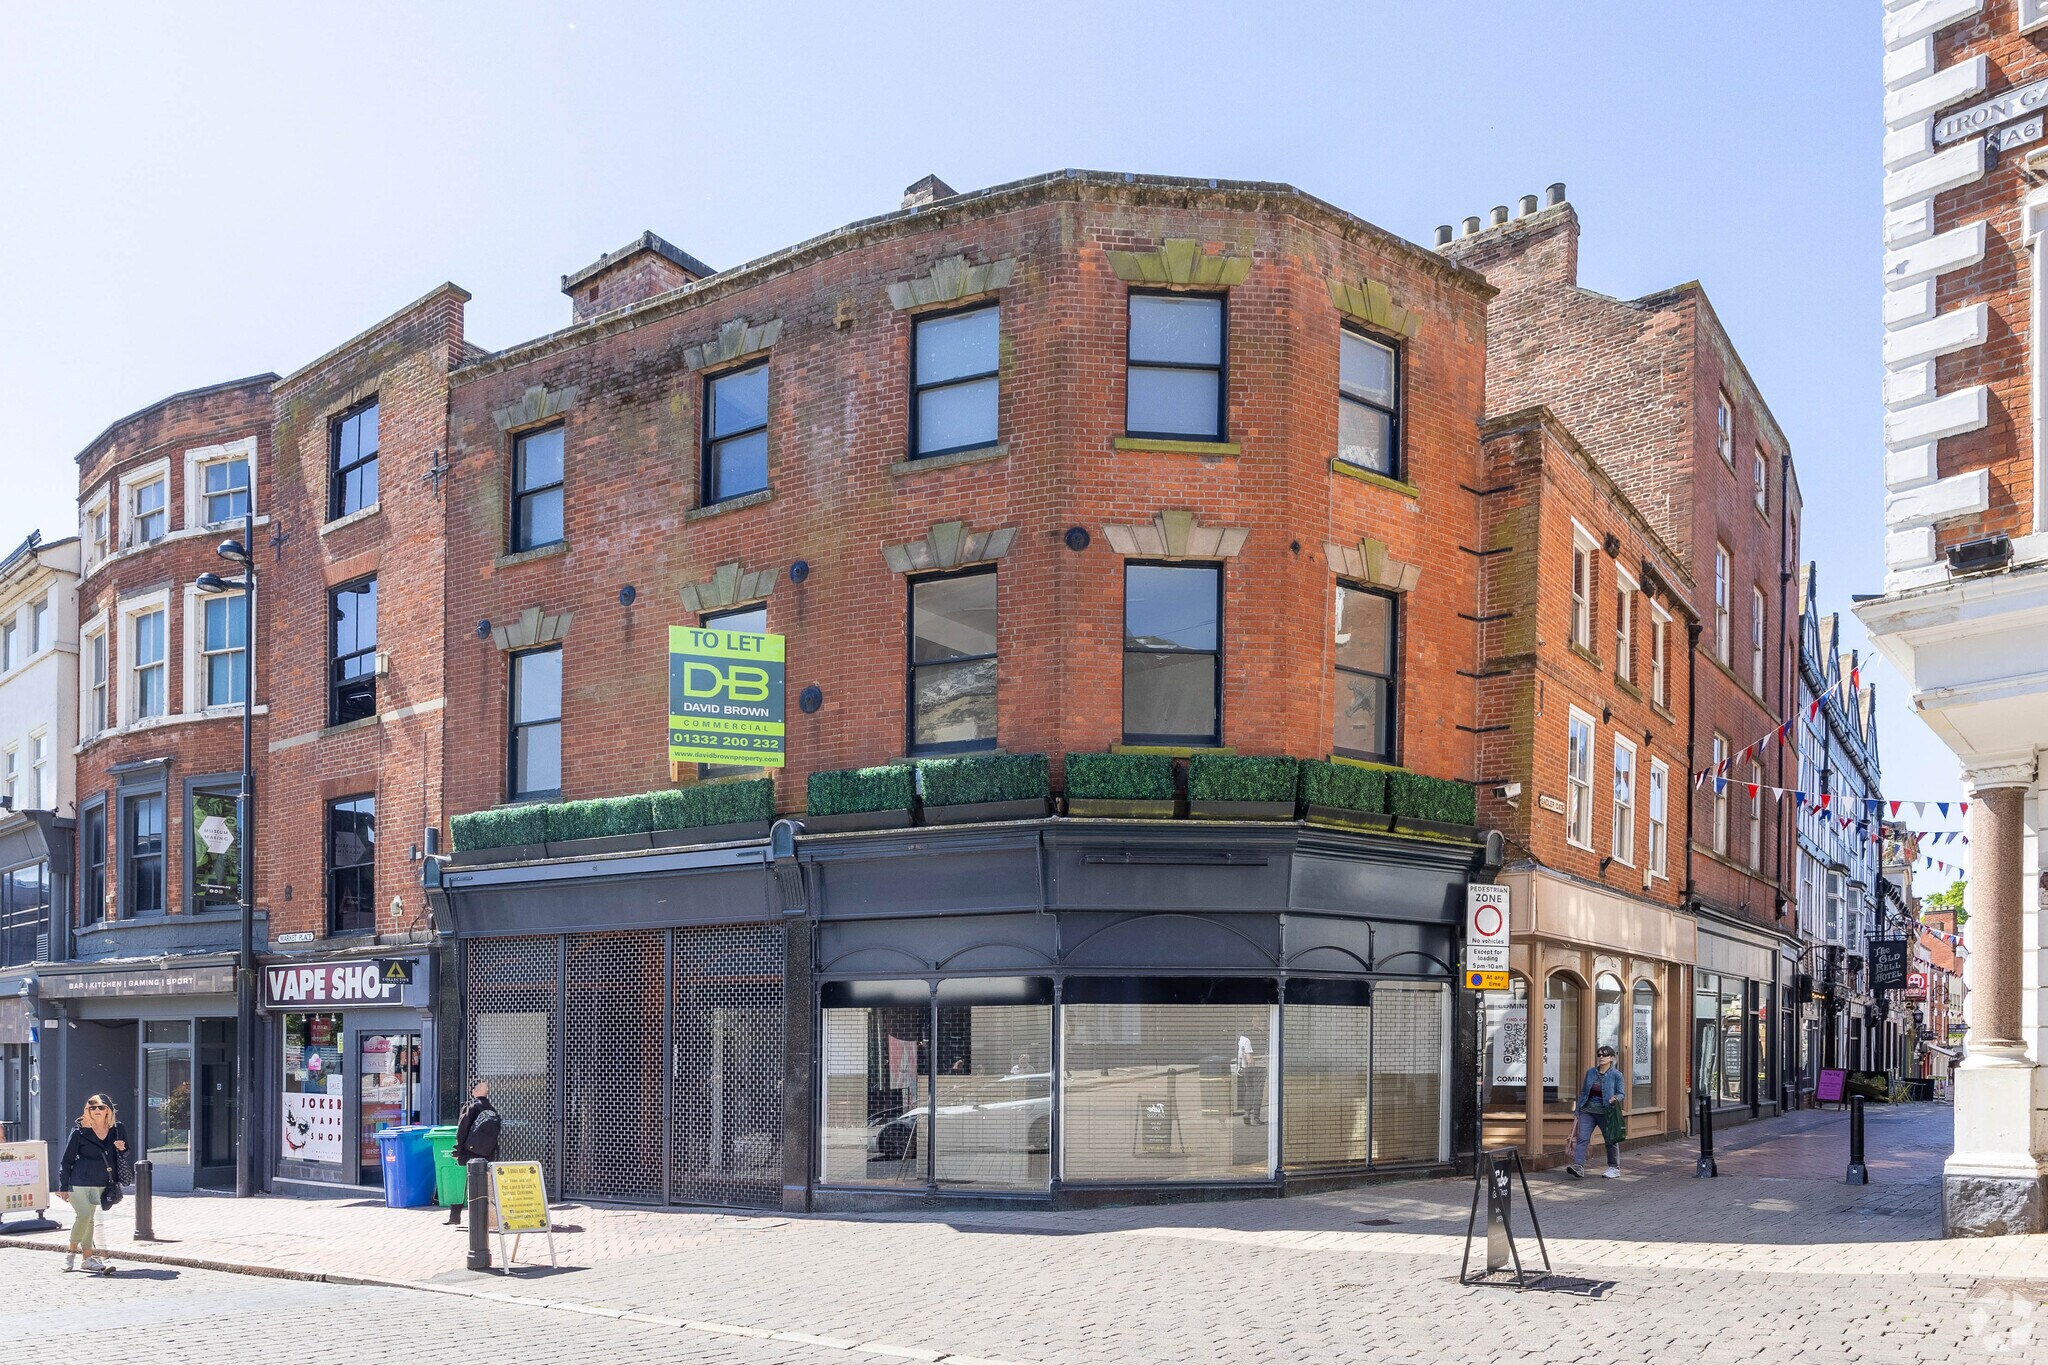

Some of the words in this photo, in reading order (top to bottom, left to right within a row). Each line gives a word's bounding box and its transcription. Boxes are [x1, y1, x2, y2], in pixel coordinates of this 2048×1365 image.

[1945, 100, 2007, 136] IRON
[2005, 124, 2036, 145] A6
[690, 630, 719, 648] TO
[727, 634, 765, 652] LET
[684, 702, 720, 713] DAVID
[724, 705, 769, 717] BROWN
[684, 720, 768, 731] COMMERCIAL
[674, 733, 718, 745] 01332
[722, 737, 749, 747] 200
[753, 738, 779, 748] 232
[674, 751, 779, 763] www.davidbrownproperty.com
[1470, 885, 1508, 893] PEDESTRIAN
[1475, 894, 1502, 903] ZONE
[280, 934, 297, 942] MARKET
[299, 933, 312, 941] PLACE
[1474, 948, 1493, 956] Except
[1874, 946, 1890, 957] The
[1875, 962, 1901, 973] BELL
[1875, 970, 1902, 982] HOTEL
[128, 978, 159, 987] GAMING
[166, 977, 193, 985] SPORT
[268, 968, 326, 1001] VAPE
[301, 1098, 342, 1109] JOKER
[311, 1117, 340, 1125] VAPE
[311, 1132, 341, 1142] SHOP
[4, 1169, 32, 1178] SALE
